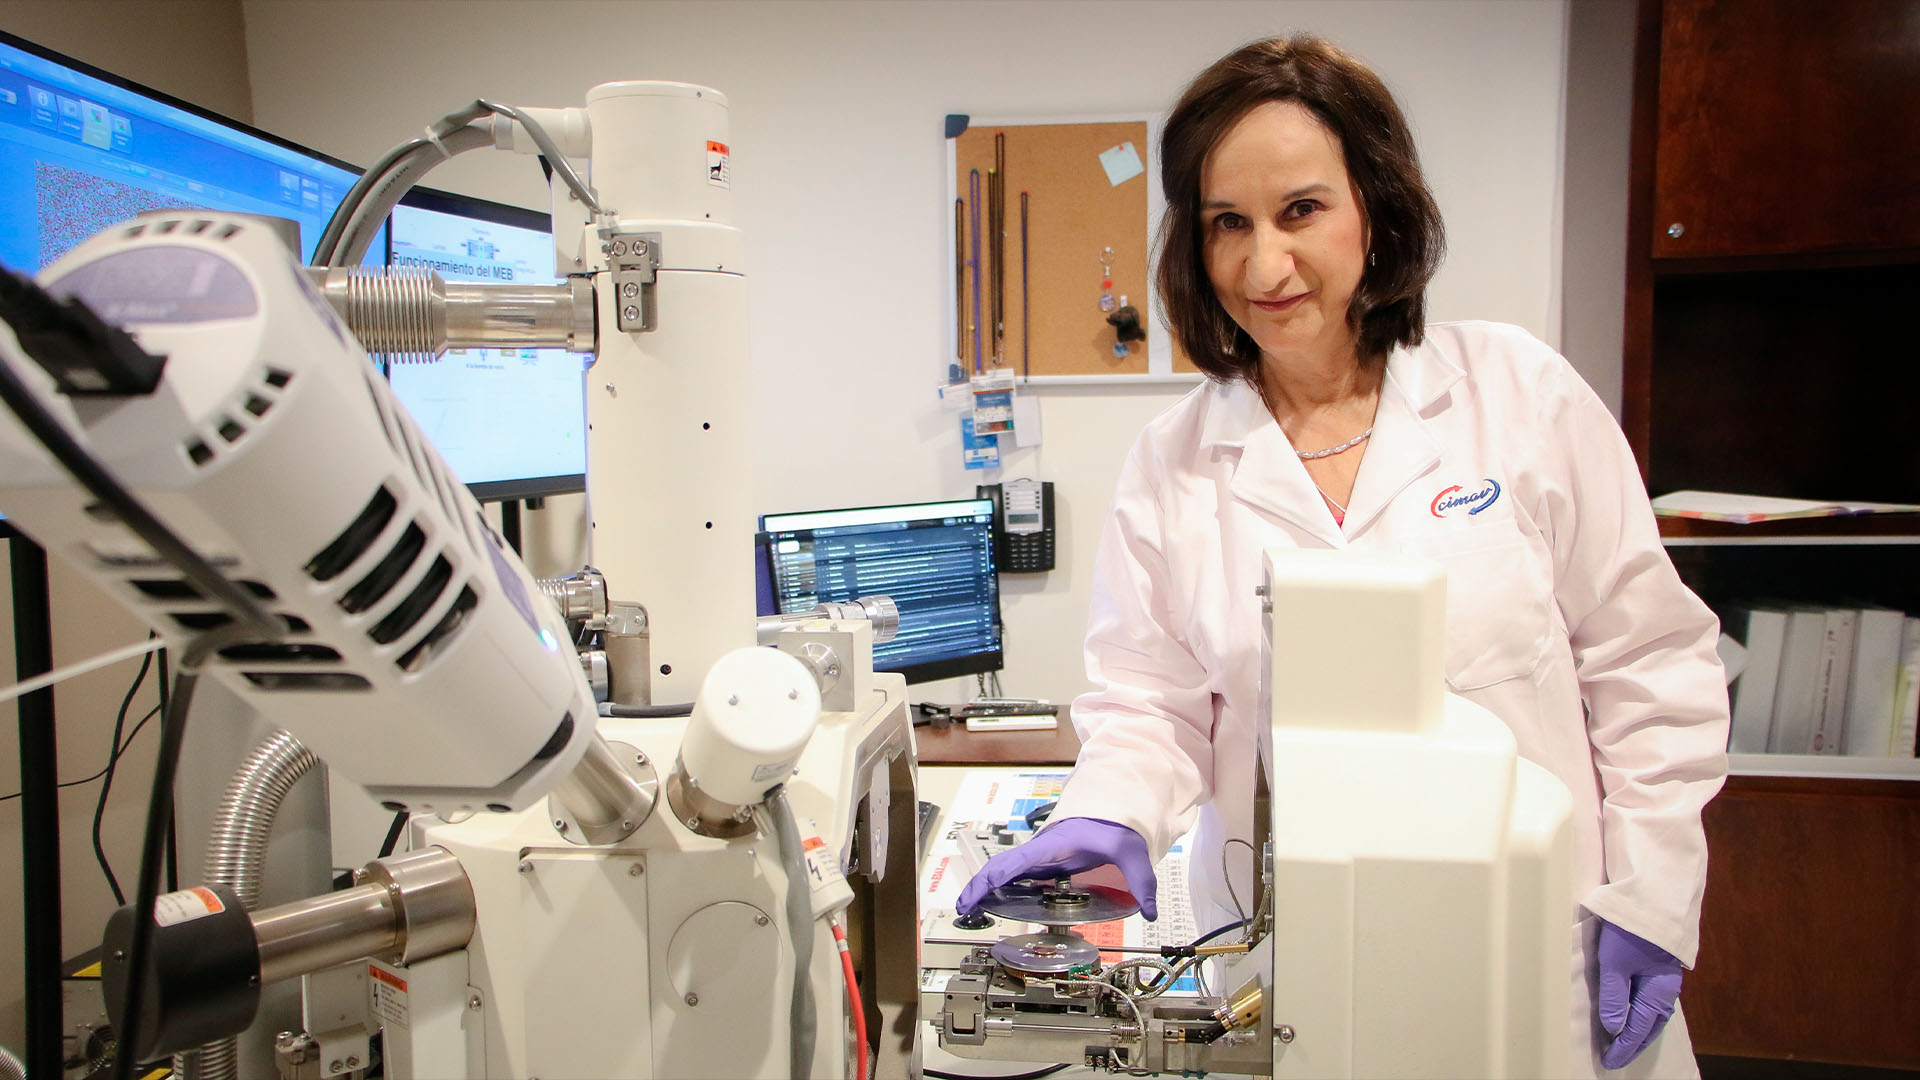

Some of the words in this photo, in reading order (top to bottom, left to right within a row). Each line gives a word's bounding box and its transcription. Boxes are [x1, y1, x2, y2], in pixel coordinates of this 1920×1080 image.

[477, 263, 491, 278] del
[493, 266, 514, 281] MEB
[1438, 487, 1493, 511] cimav
